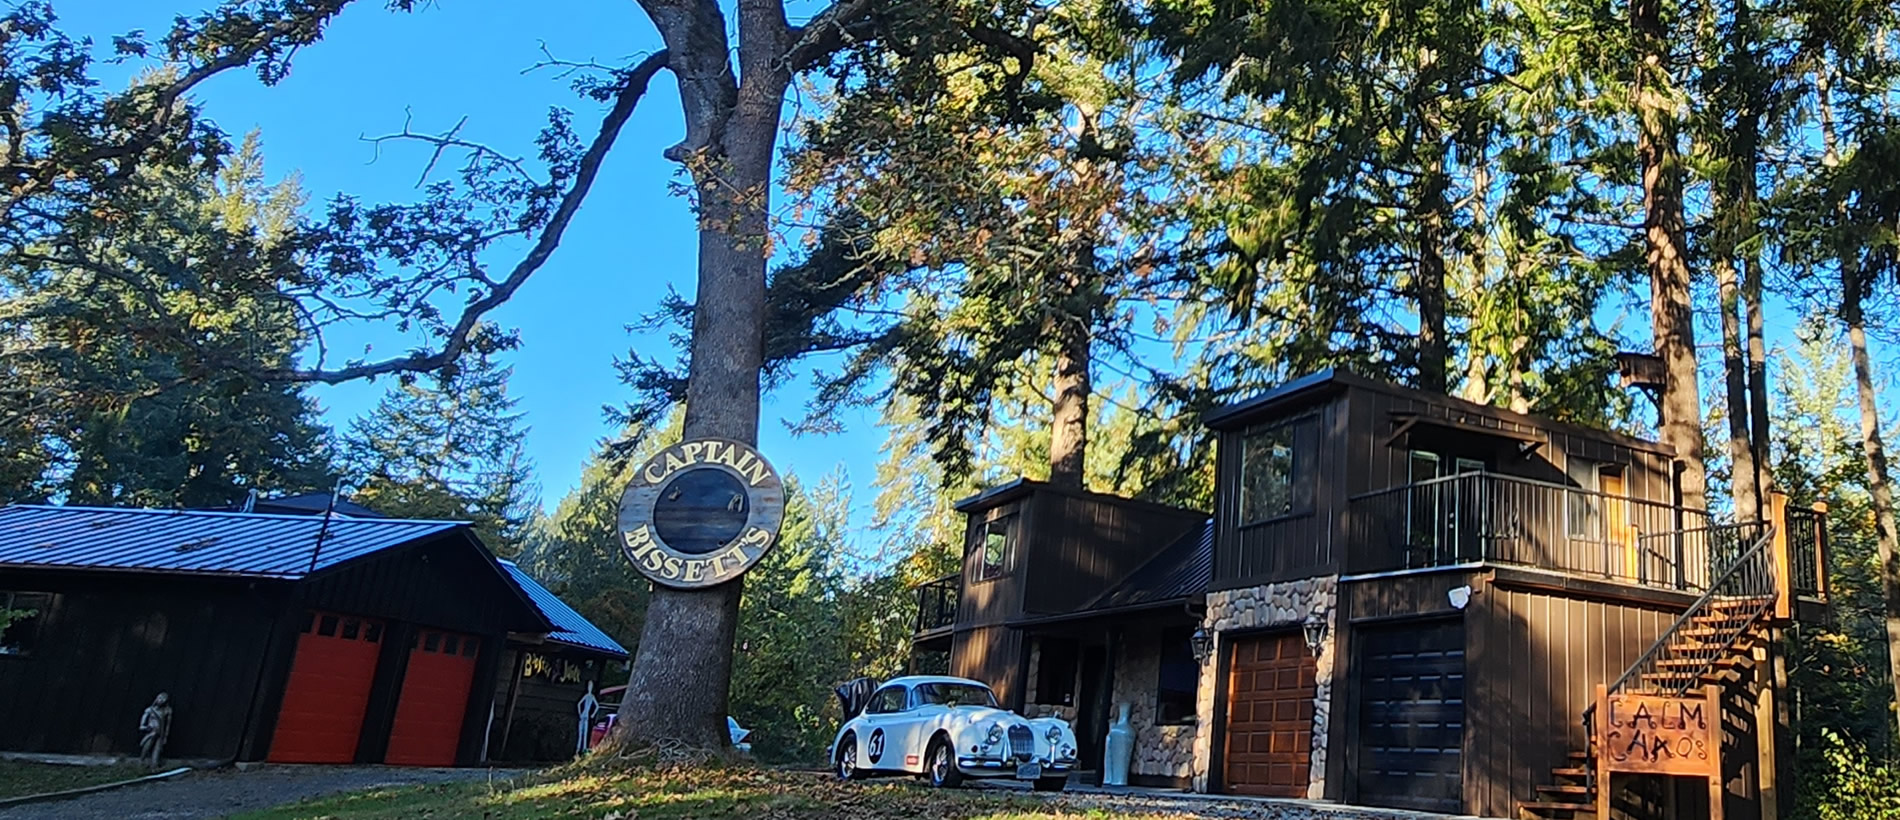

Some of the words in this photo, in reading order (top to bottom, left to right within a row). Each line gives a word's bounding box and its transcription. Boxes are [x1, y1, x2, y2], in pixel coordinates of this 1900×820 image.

[644, 441, 771, 486] CAPTAIN
[624, 524, 770, 582] BISSETT'S
[1610, 699, 1706, 730] CALM
[869, 734, 884, 757] 61
